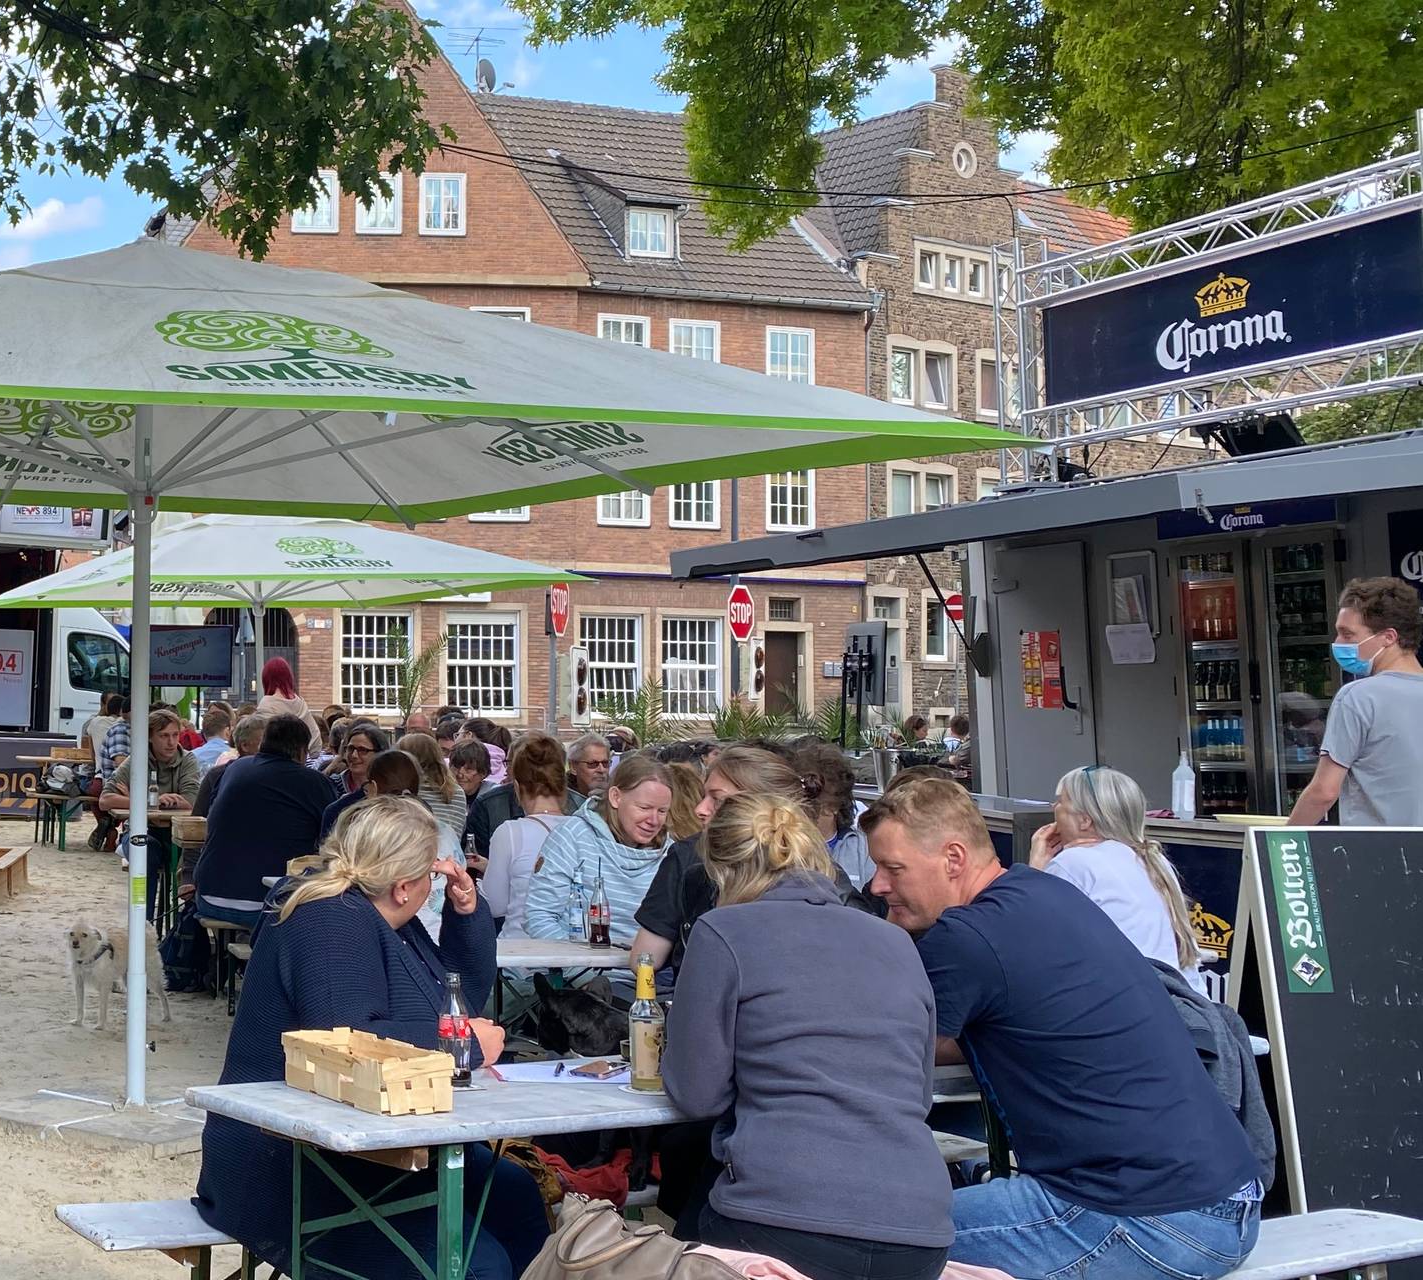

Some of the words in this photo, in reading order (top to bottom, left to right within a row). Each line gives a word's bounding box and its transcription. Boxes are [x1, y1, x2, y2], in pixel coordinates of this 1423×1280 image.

[1156, 310, 1290, 373] Corona
[166, 360, 477, 391] SOMERSBY
[373, 384, 428, 392] OVER
[1220, 513, 1265, 531] Corona
[285, 559, 394, 569] SOMERSBY
[553, 587, 568, 615] STOP
[730, 602, 753, 625] STOP
[1281, 838, 1317, 948] Bolten
